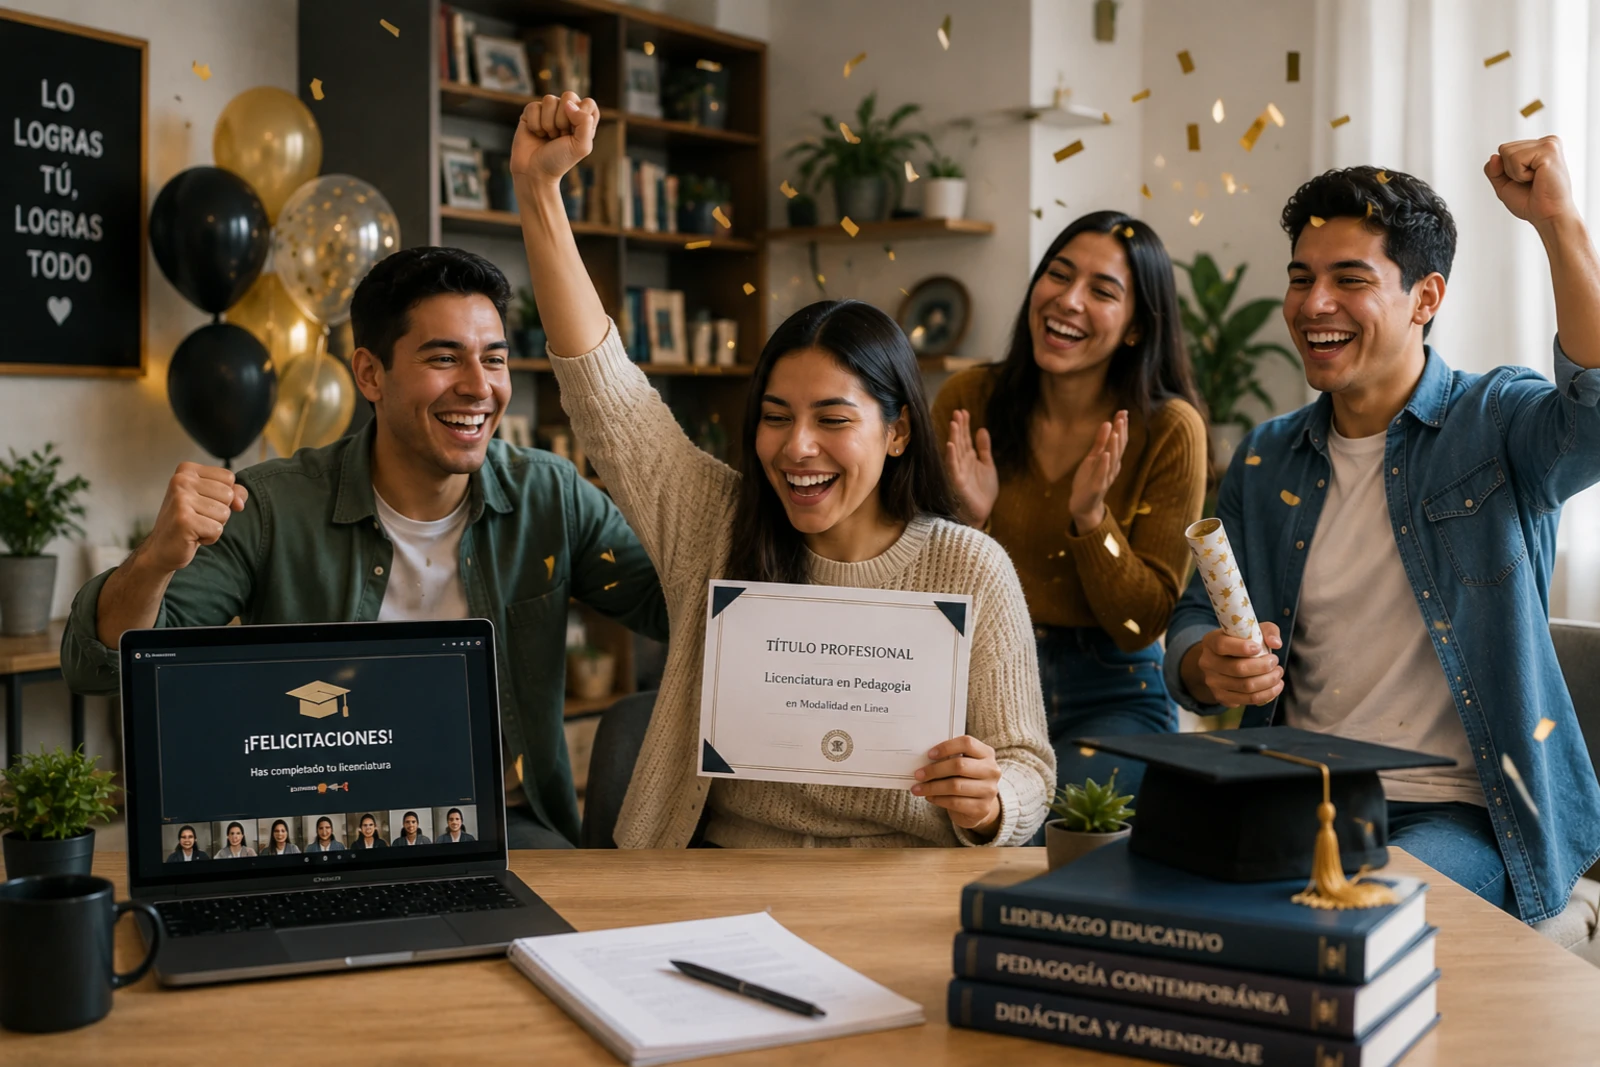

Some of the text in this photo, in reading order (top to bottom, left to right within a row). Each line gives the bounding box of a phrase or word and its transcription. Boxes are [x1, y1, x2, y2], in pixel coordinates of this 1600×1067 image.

[41, 79, 75, 112] LO
[14, 117, 103, 158] LOGRAS
[39, 162, 78, 200] TÚ,
[15, 204, 103, 241] LOGRAS
[26, 249, 92, 282] TODO
[766, 638, 914, 661] TÍTULO PROFESIONAL
[764, 671, 834, 687] Licenciatura
[836, 678, 851, 688] en
[785, 700, 797, 708] en
[799, 699, 849, 711] Modalidad
[850, 704, 862, 712] en
[244, 729, 393, 755] ¡FELICITACIONES!
[250, 767, 269, 777] Has
[270, 763, 325, 777] completado
[338, 761, 391, 772] licenciatura
[1000, 905, 1223, 953] LIDERAZGO EDUCATIVO
[996, 952, 1289, 1016] PEDAGOGÍA CONTEMPORÁNEA
[995, 1001, 1264, 1065] DIDÁCTICA Y APRENDIZAJE
